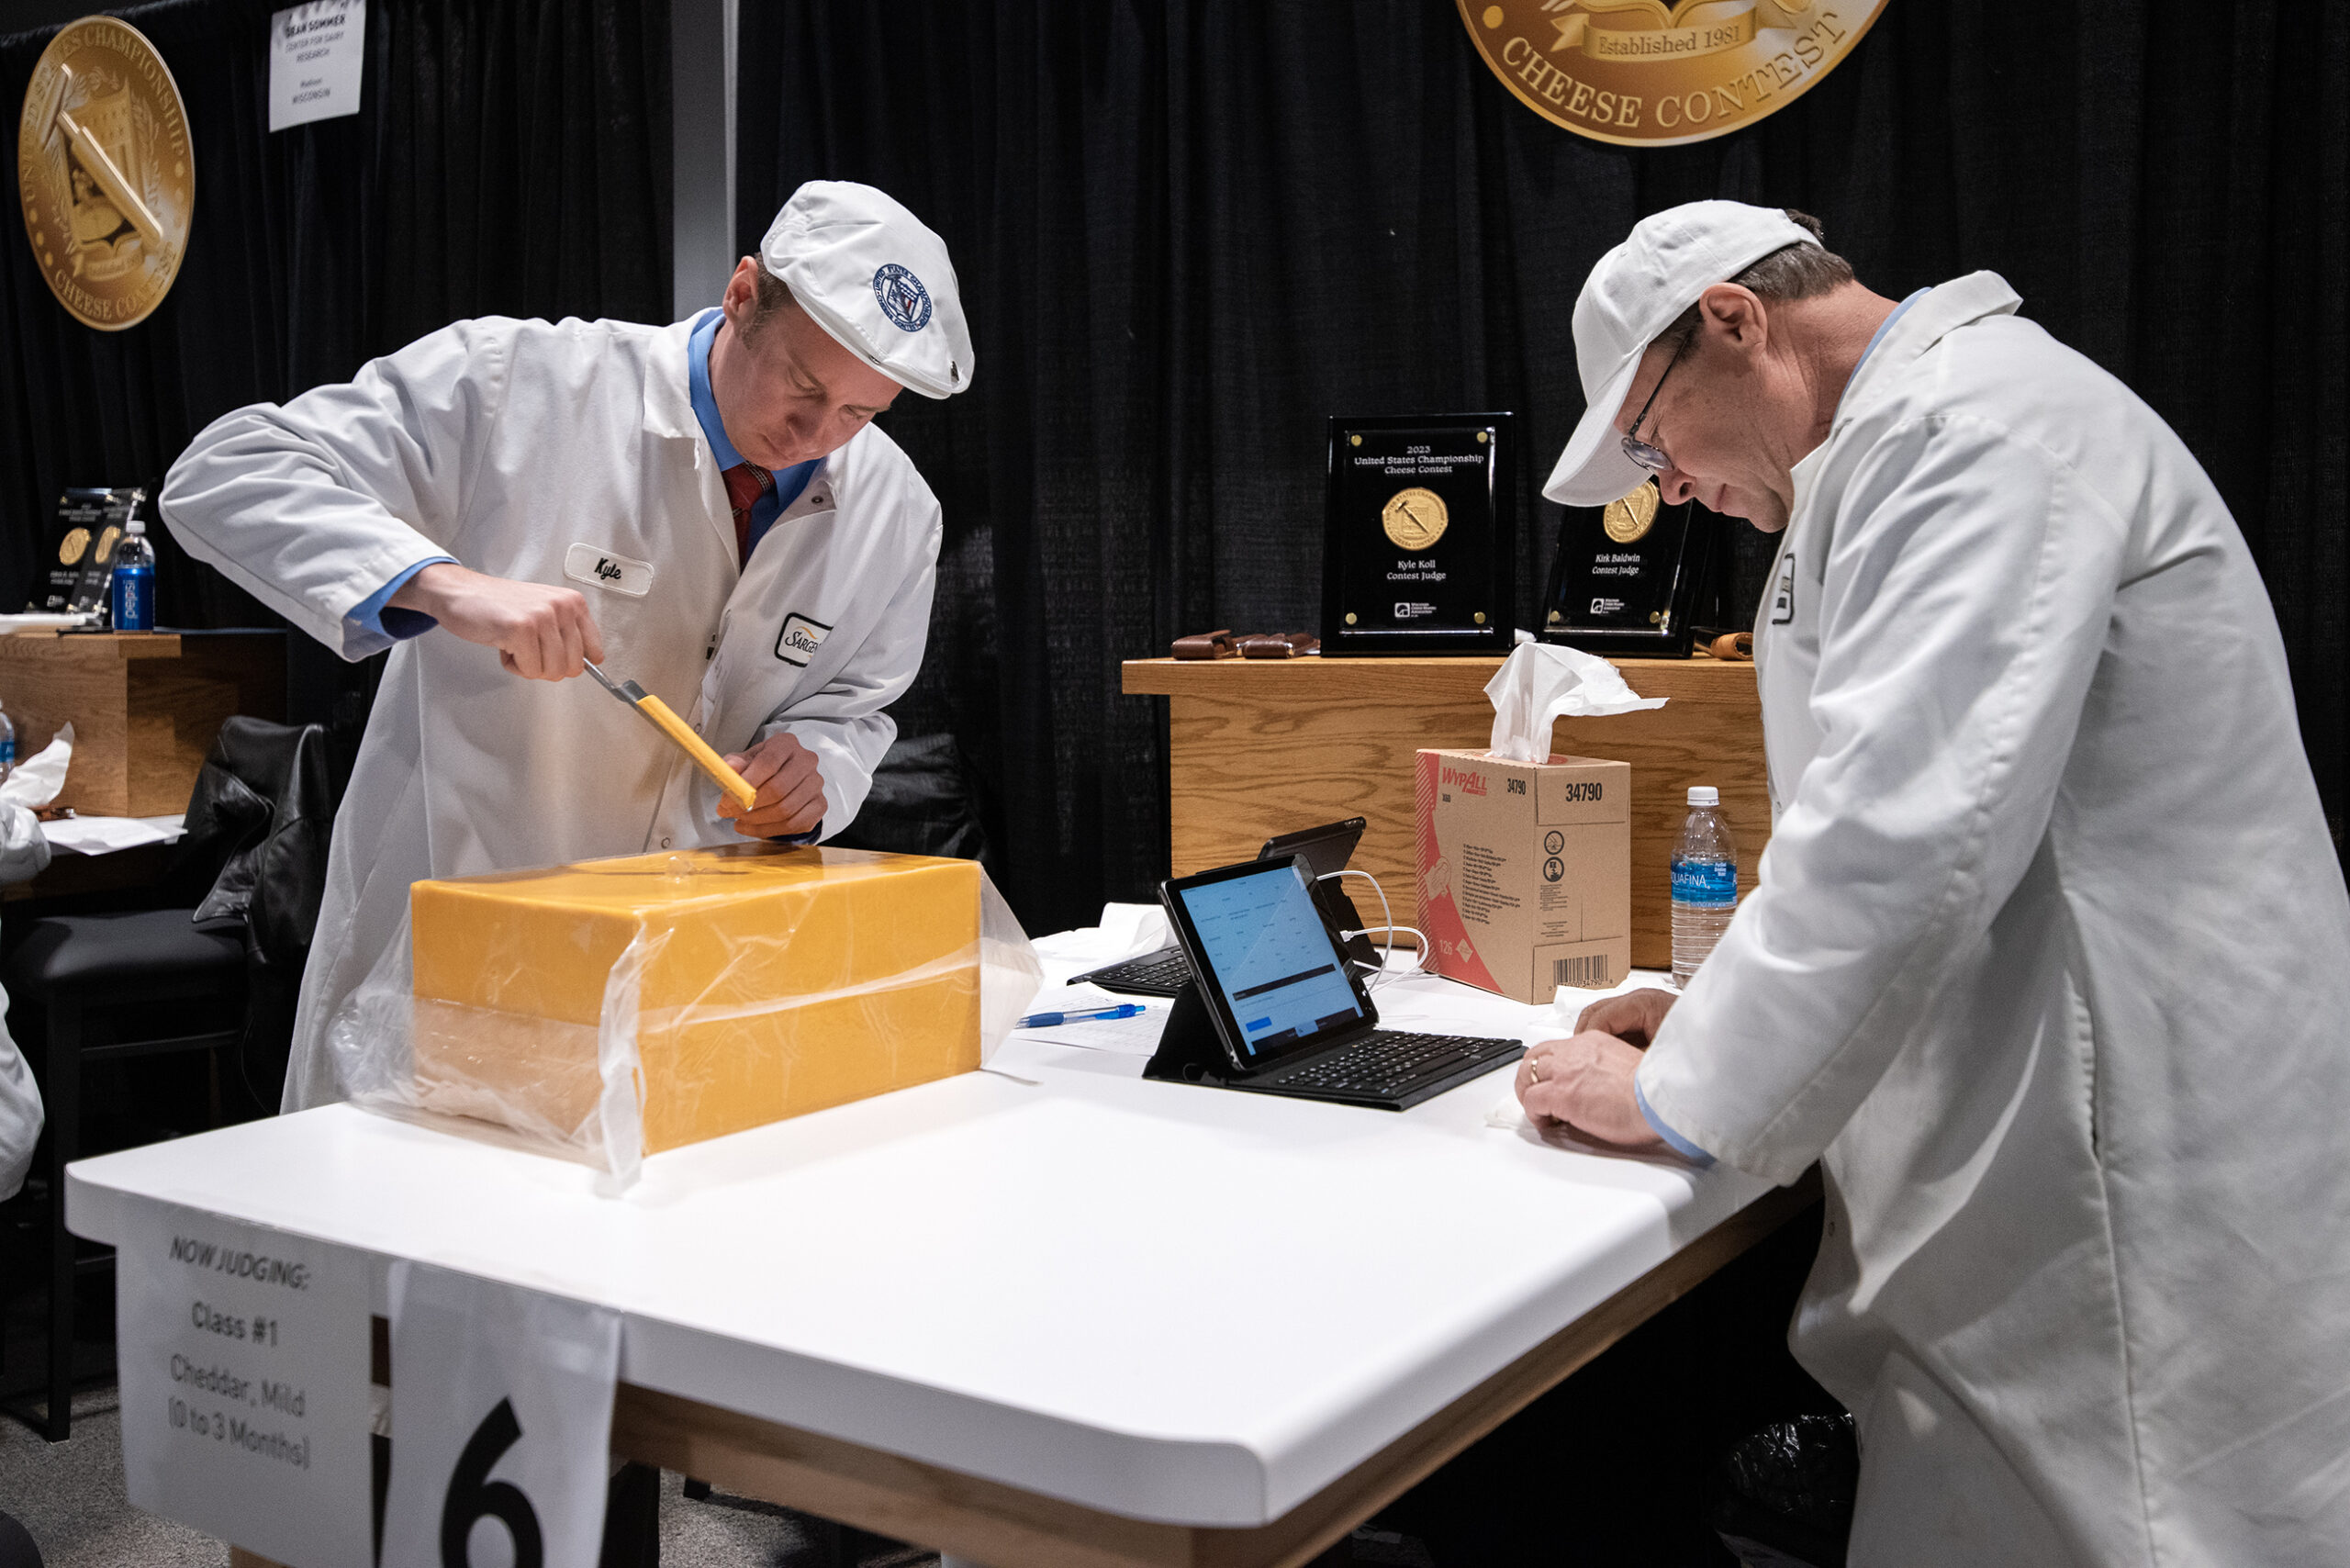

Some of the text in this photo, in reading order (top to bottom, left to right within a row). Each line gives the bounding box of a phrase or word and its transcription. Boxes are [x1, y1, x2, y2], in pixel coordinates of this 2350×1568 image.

[1597, 24, 1742, 57] Established 1981
[1502, 10, 1849, 129] CHEESE CONTEST
[84, 24, 185, 156] CHAMPIONSHIP
[55, 269, 112, 320] CHEESE
[1354, 454, 1485, 465] United States Championship
[1384, 465, 1452, 475] Cheese Contest
[594, 557, 621, 580] Kyle
[1397, 559, 1436, 571] Kyle Koll
[1592, 566, 1639, 577] Contest Judge
[1595, 554, 1640, 563] Kirk Baldwin
[1386, 571, 1447, 581] Contest Judge
[123, 580, 138, 619] pepsi
[1507, 778, 1527, 796] 34790
[1565, 782, 1603, 802] 34790
[1671, 871, 1707, 888] QUAFINA
[169, 1234, 311, 1292] NOW JUDGING:
[192, 1301, 278, 1349] Class #1
[261, 1378, 307, 1418] Mild
[189, 1407, 210, 1436] to
[212, 1411, 226, 1441] 3
[229, 1417, 310, 1470] Months)
[441, 1394, 543, 1568] 6
